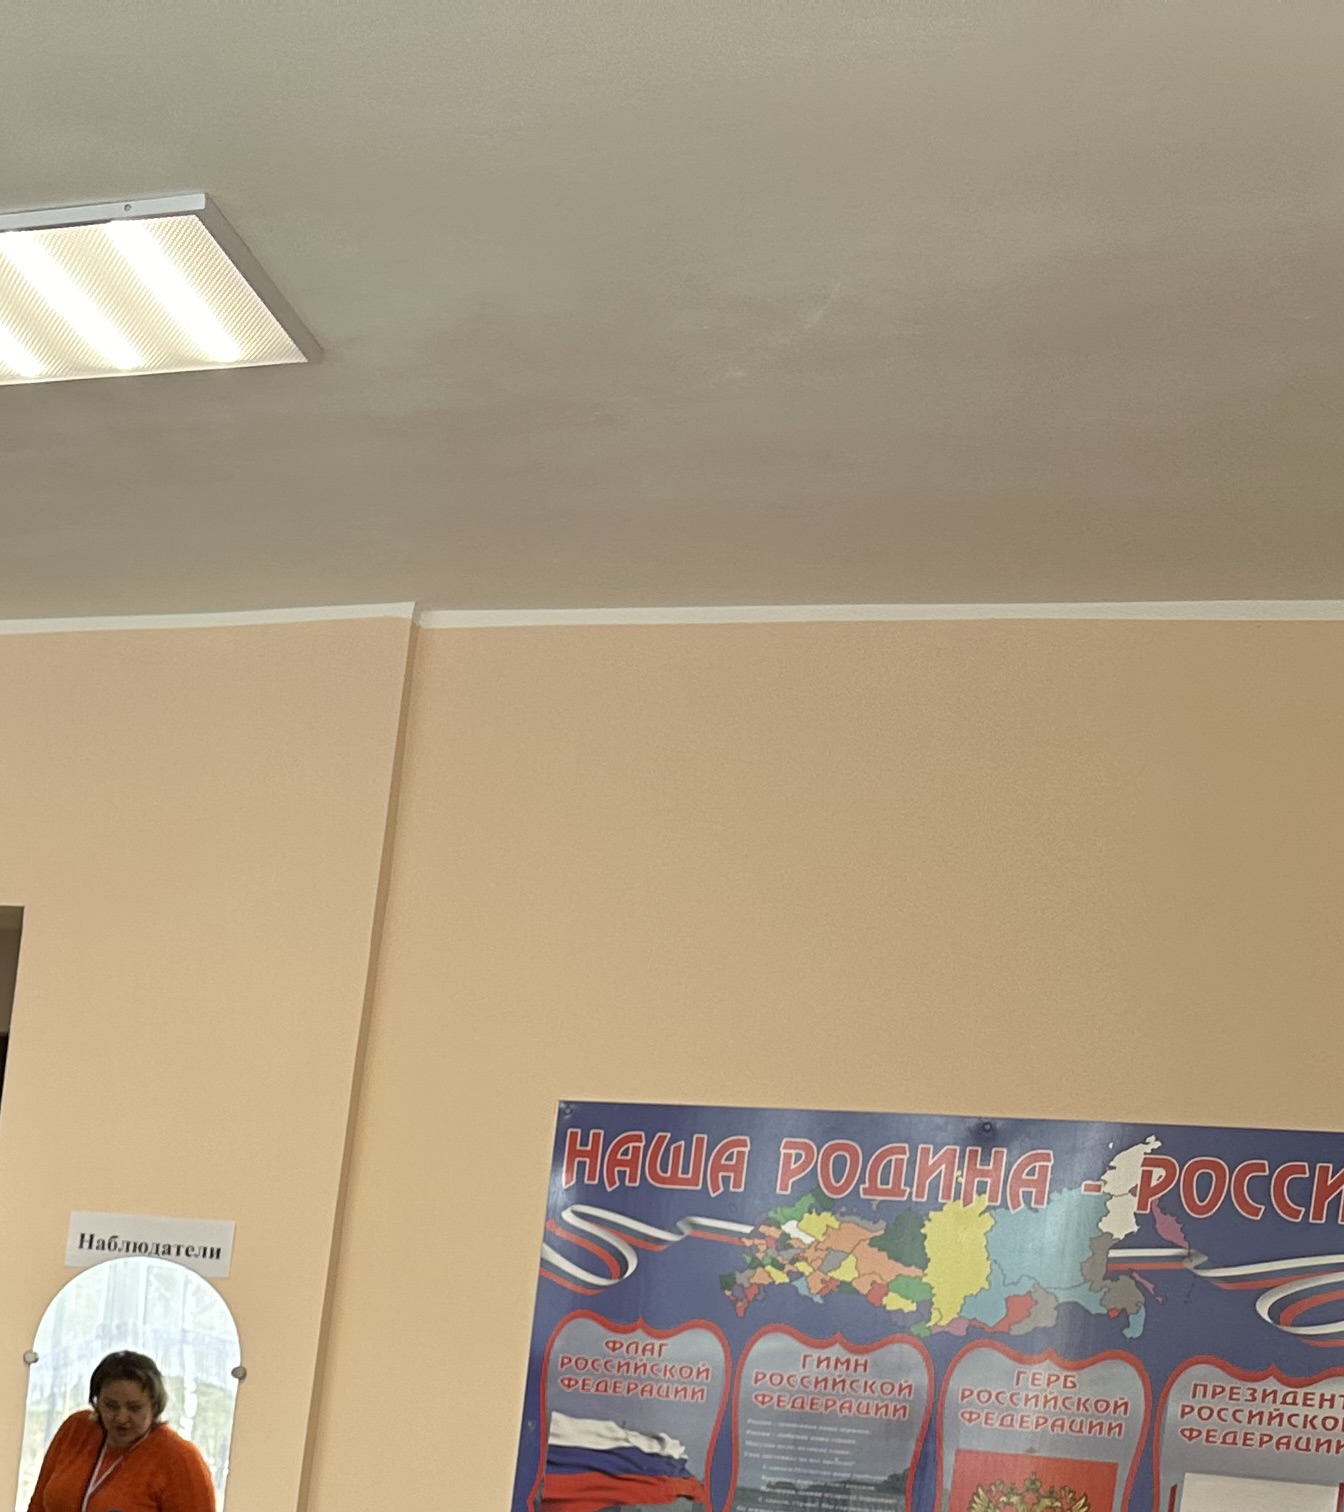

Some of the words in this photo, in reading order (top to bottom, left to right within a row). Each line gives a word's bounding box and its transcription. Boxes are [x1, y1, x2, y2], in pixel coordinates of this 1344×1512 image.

[561, 1127, 752, 1197] НАША
[775, 1137, 1054, 1212] РОДИНА
[1135, 1154, 1344, 1226] РОССИ
[78, 1232, 222, 1260] Наблюдатели
[604, 1338, 670, 1359] ФЛАГ
[558, 1355, 711, 1382] РОССИЙСКОЙ
[801, 1353, 869, 1374] ГИМН
[558, 1375, 707, 1402] ФЕДЕРАЦИИ
[753, 1370, 914, 1399] РОССИЙСКОЙ
[1014, 1369, 1079, 1390] ГЕРБ
[753, 1392, 909, 1420] ФЕДЕРАЦИИ
[959, 1387, 1130, 1417] РОССИЙСКОЙ
[960, 1410, 1125, 1438] ФЕДЕРАЦИИ
[1180, 1403, 1344, 1433] РОССИЙСКО
